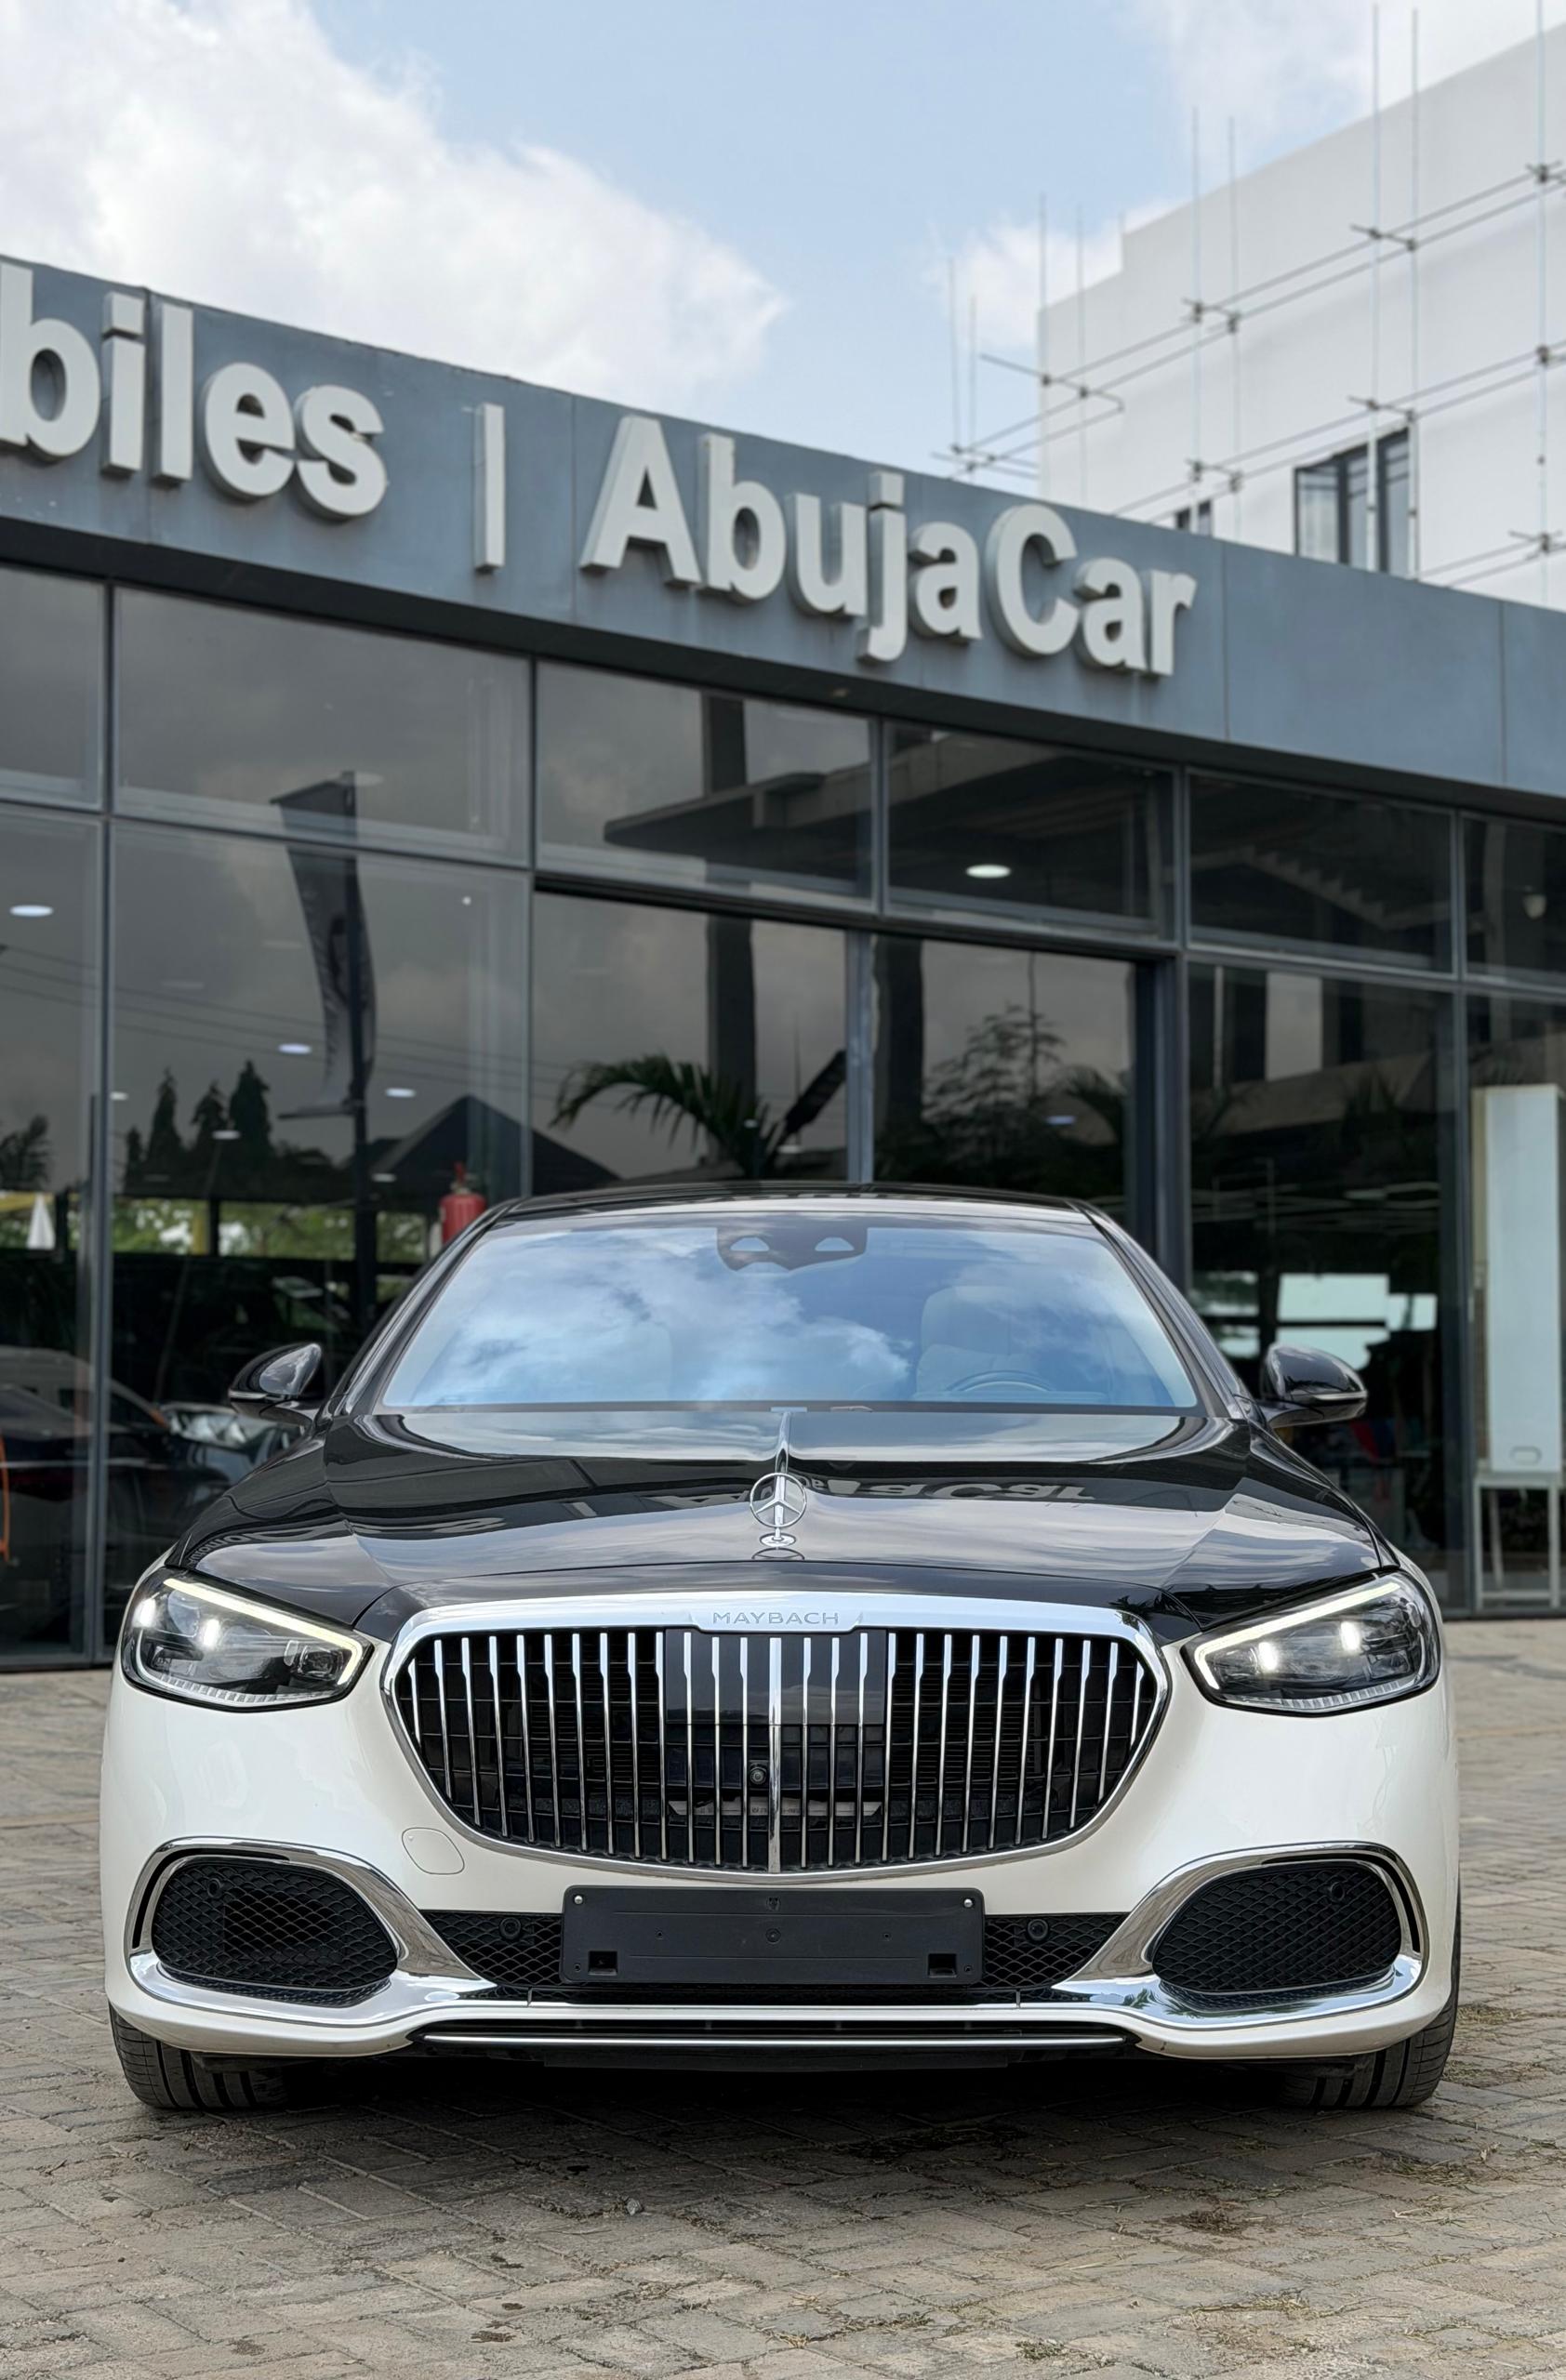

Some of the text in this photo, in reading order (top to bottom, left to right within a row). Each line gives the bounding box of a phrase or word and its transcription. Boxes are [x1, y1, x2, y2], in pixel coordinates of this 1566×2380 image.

[0, 254, 388, 518] biles
[578, 415, 1198, 678] AbujaCar
[712, 1611, 839, 1625] MAYBACH
